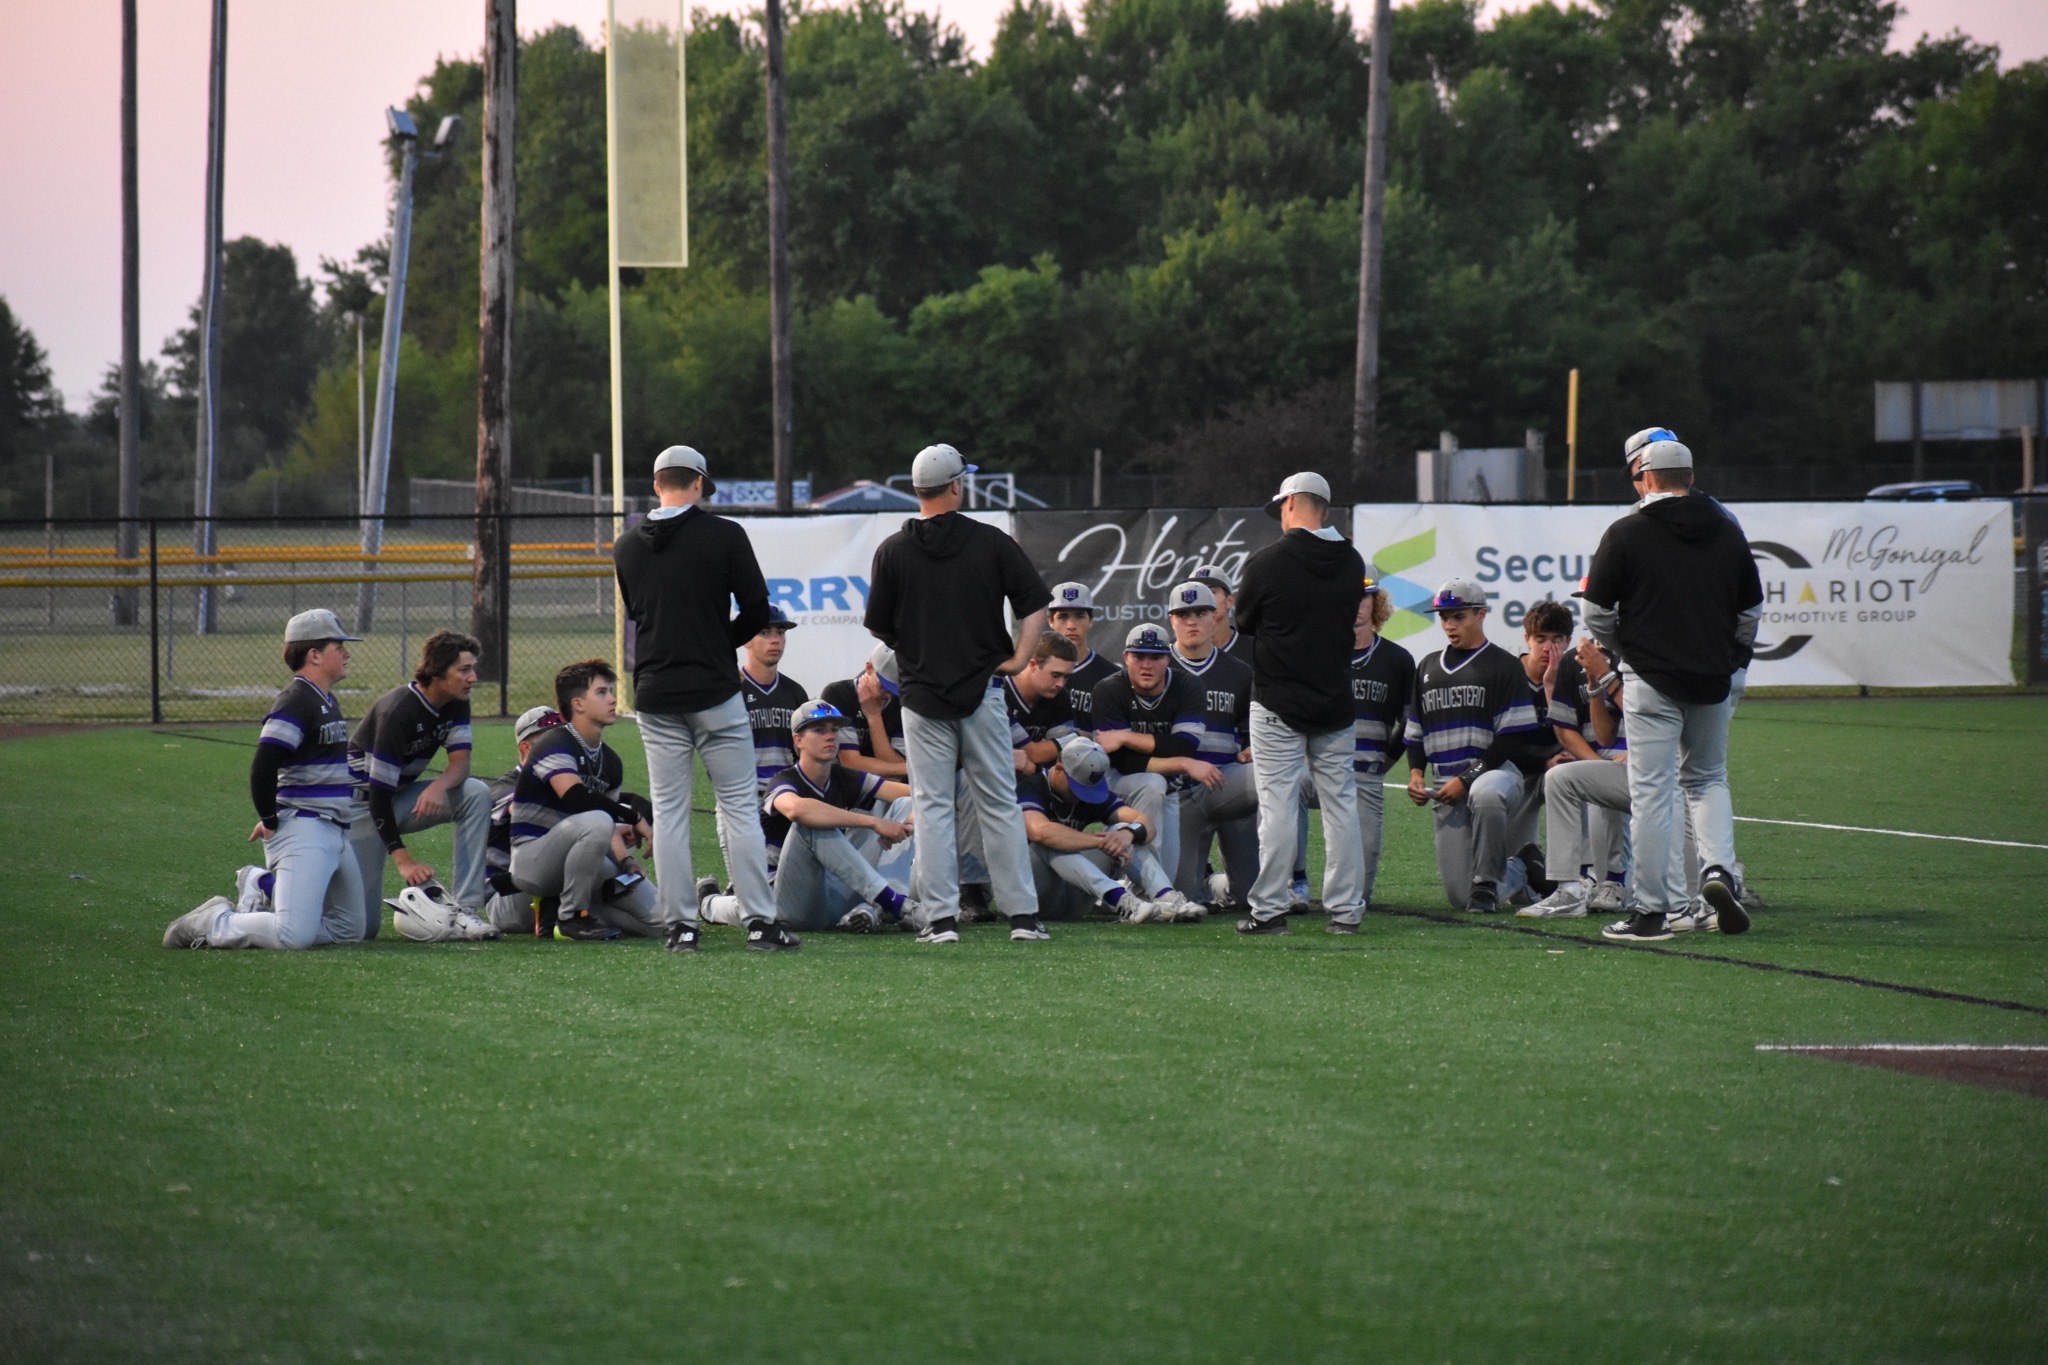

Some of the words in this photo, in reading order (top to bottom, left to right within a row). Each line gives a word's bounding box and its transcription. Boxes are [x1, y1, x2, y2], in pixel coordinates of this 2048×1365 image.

[1058, 516, 1250, 599] Herita
[1822, 525, 1989, 594] McGonigal
[1762, 611, 1848, 624] TOMOTIVE
[1857, 610, 1916, 623] GROUP
